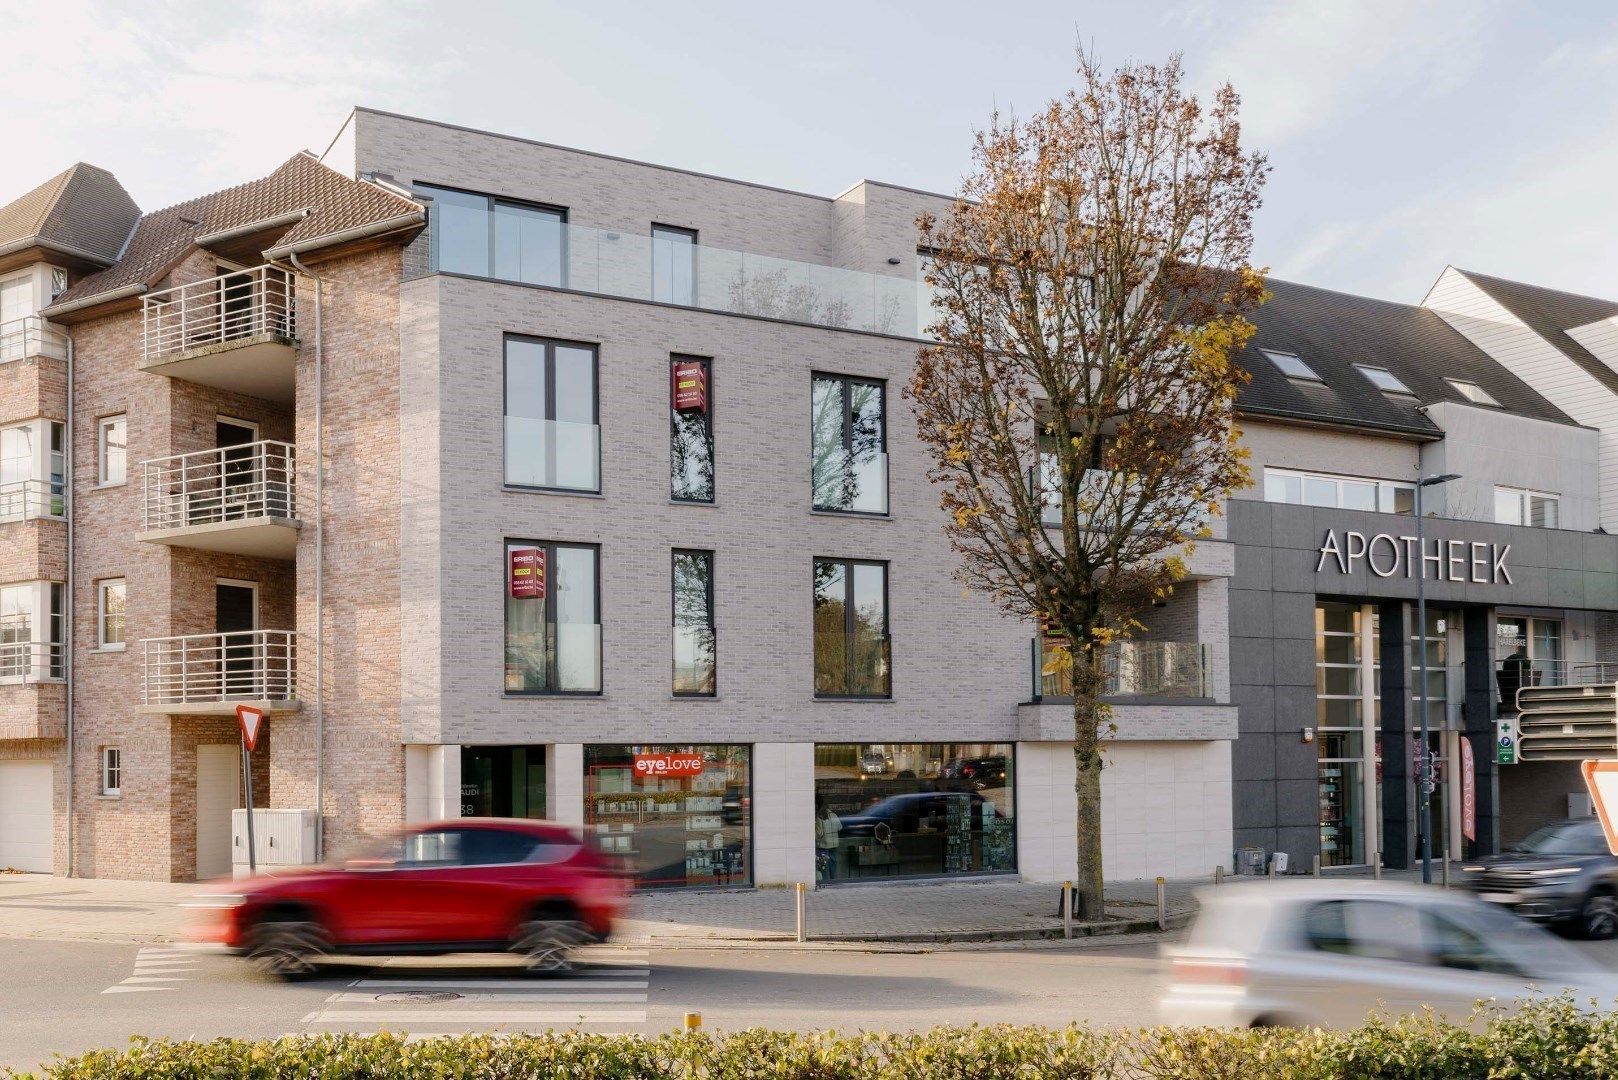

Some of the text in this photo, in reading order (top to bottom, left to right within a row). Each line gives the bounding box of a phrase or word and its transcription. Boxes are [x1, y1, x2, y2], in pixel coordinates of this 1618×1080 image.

[1316, 528, 1513, 585] APOTHEEK
[636, 756, 701, 774] eyelove
[461, 788, 480, 796] AUDI
